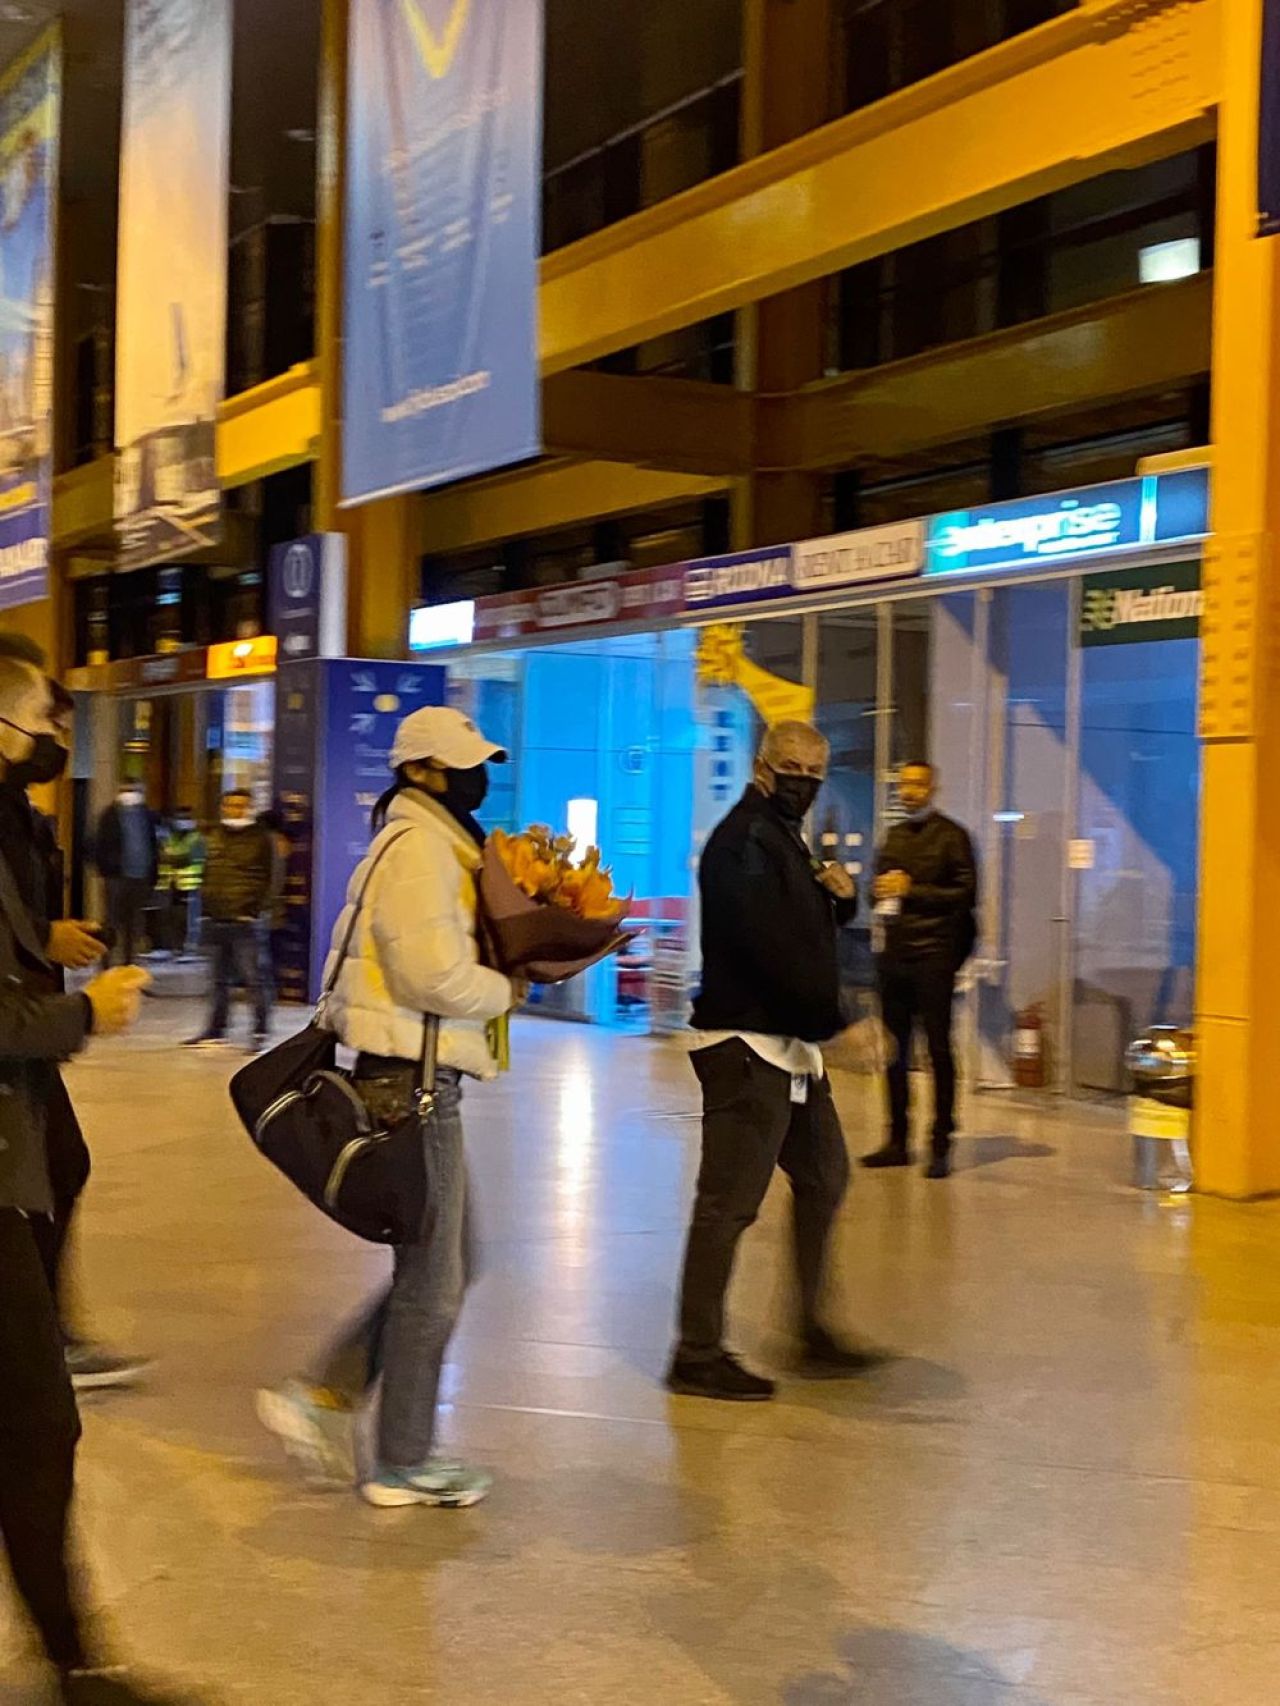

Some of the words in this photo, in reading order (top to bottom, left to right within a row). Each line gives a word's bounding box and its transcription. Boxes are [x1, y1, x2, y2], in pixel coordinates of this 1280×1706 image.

[932, 499, 1122, 557] enterprise
[800, 548, 853, 580] RENT
[874, 536, 917, 568] CAR
